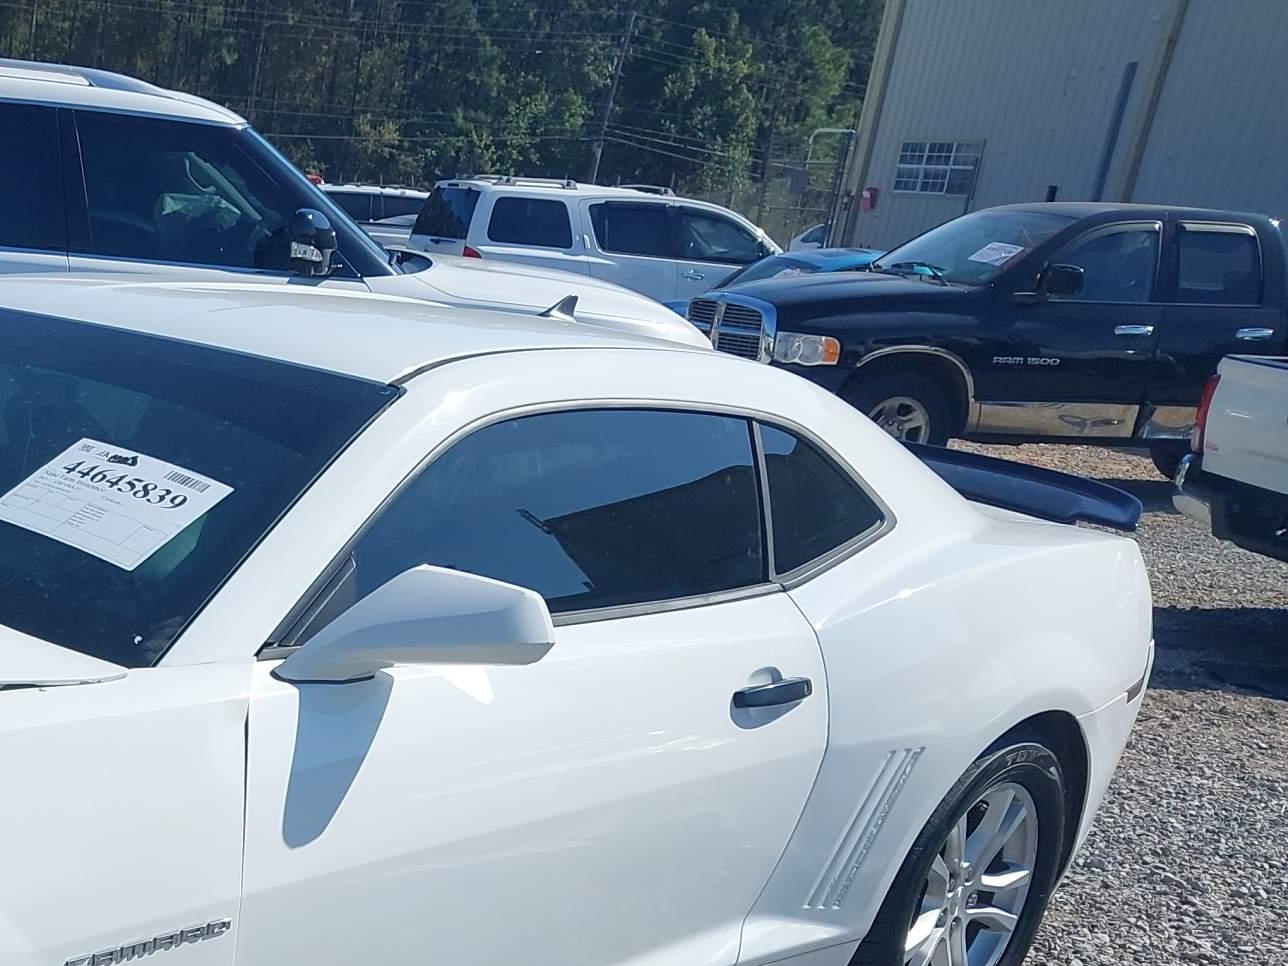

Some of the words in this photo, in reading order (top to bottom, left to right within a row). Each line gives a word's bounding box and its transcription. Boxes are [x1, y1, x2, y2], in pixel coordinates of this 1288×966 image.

[992, 356, 1024, 365] RAM
[1026, 357, 1061, 366] 1500
[63, 460, 188, 509] 44645839
